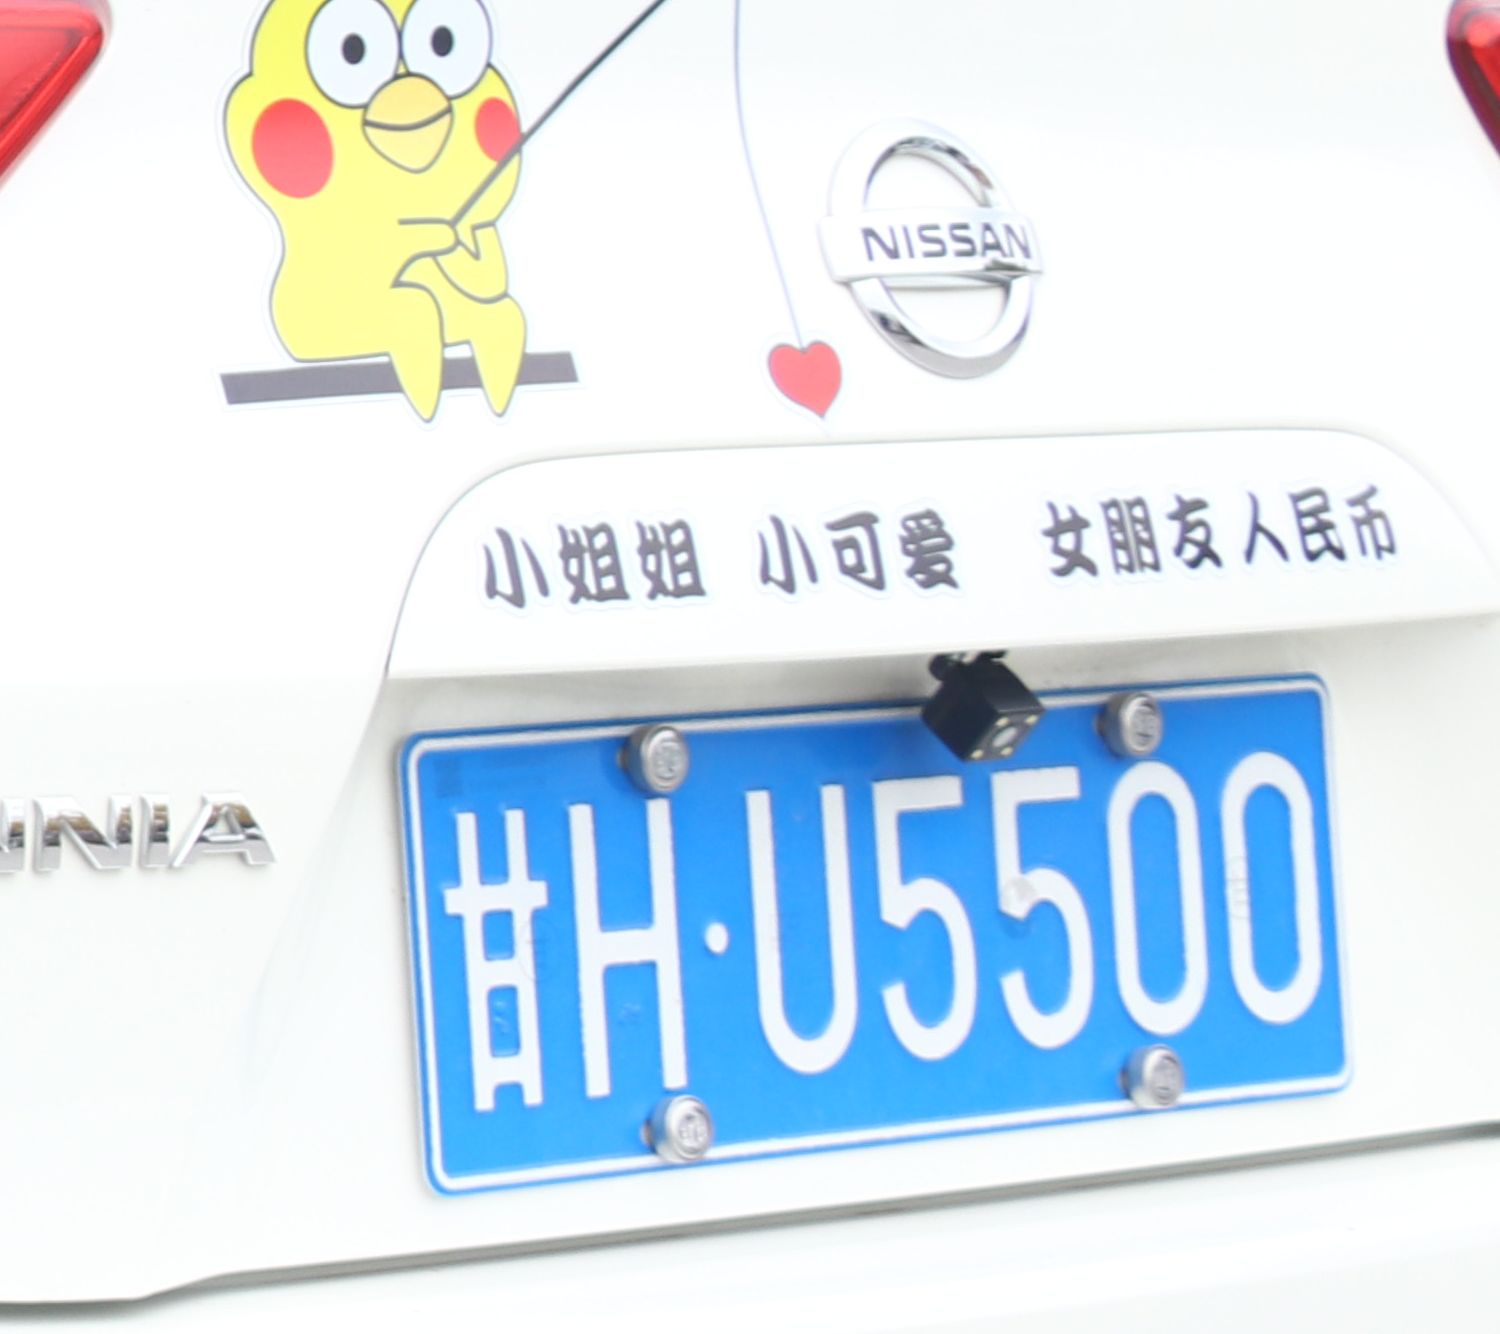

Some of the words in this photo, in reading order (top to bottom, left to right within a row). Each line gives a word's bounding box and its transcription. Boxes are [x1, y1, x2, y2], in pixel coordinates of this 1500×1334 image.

[860, 221, 1034, 262] NISSAN
[482, 519, 706, 609] 小姐姐
[758, 509, 960, 595] 小可爱
[1042, 485, 1400, 577] 女朋友人民币
